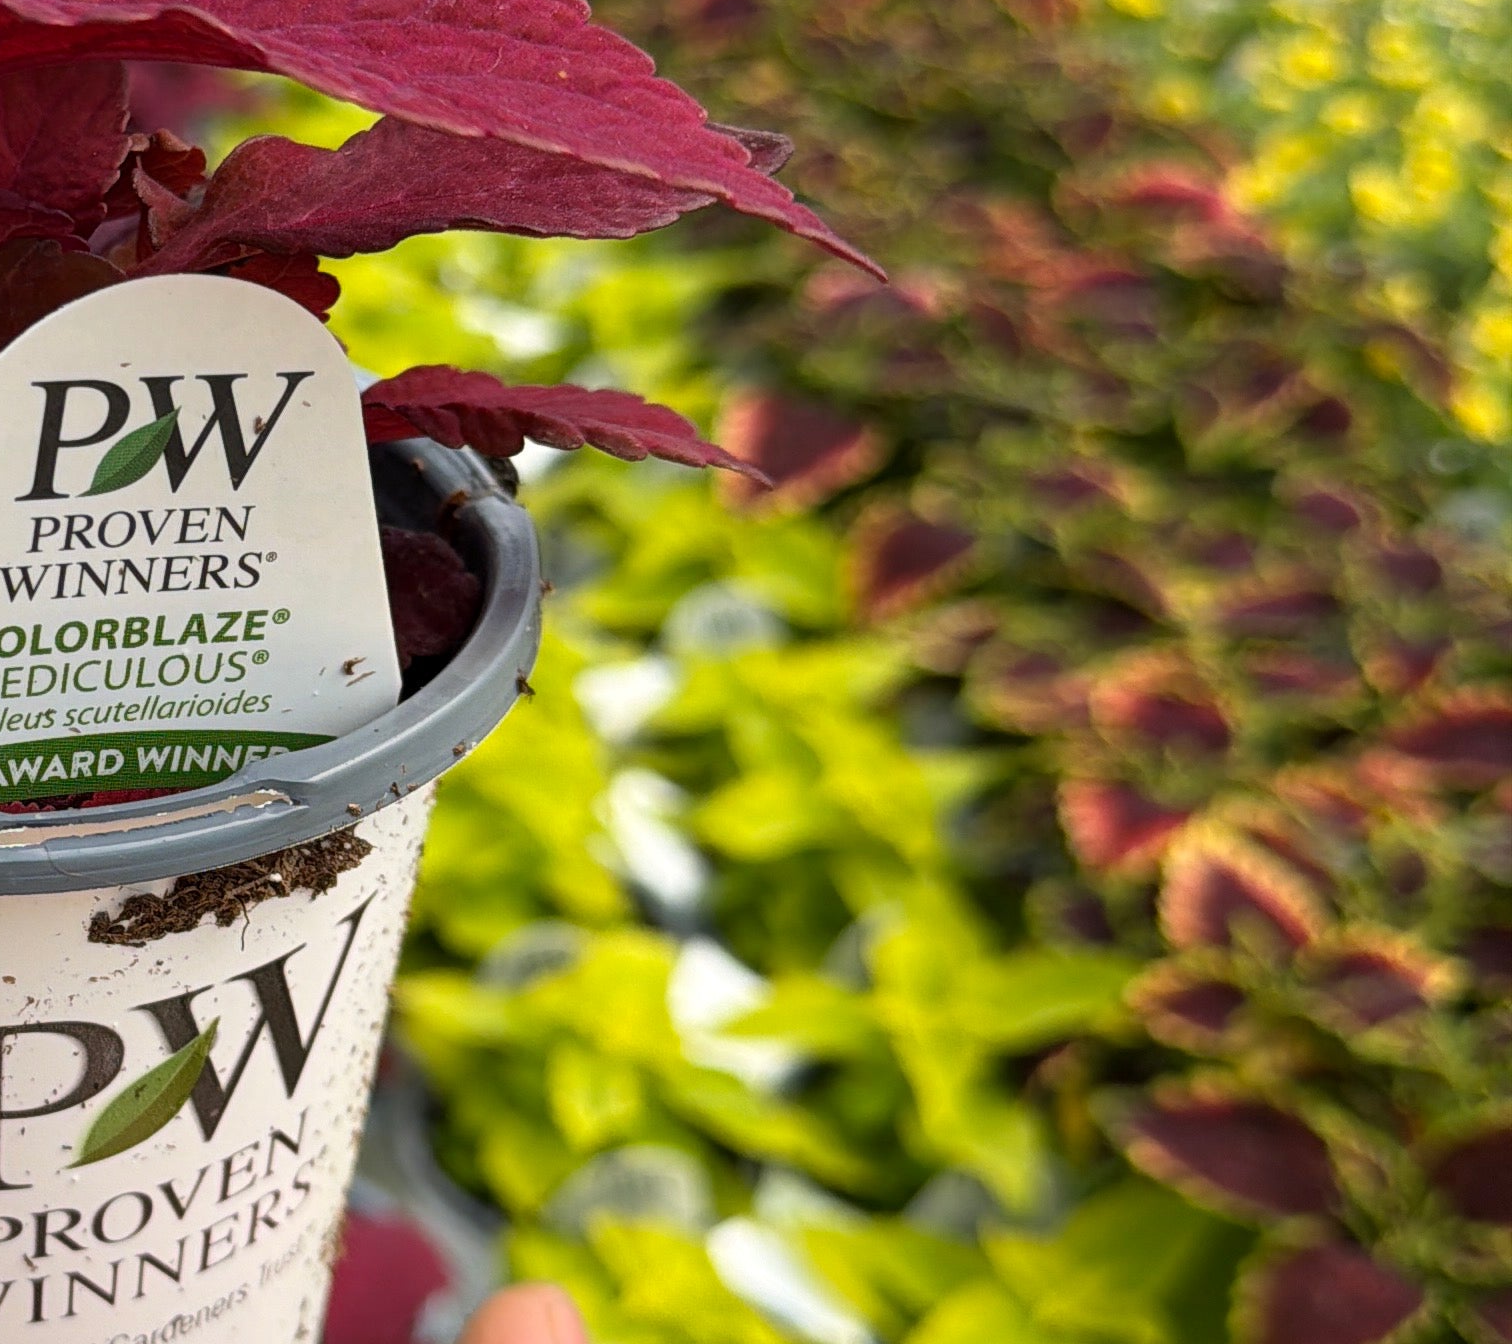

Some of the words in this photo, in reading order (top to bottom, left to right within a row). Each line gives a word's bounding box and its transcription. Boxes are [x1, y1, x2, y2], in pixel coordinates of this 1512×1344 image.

[14, 370, 316, 502] PW
[28, 505, 256, 554] PROVEN
[62, 689, 273, 728] scutellarioides
